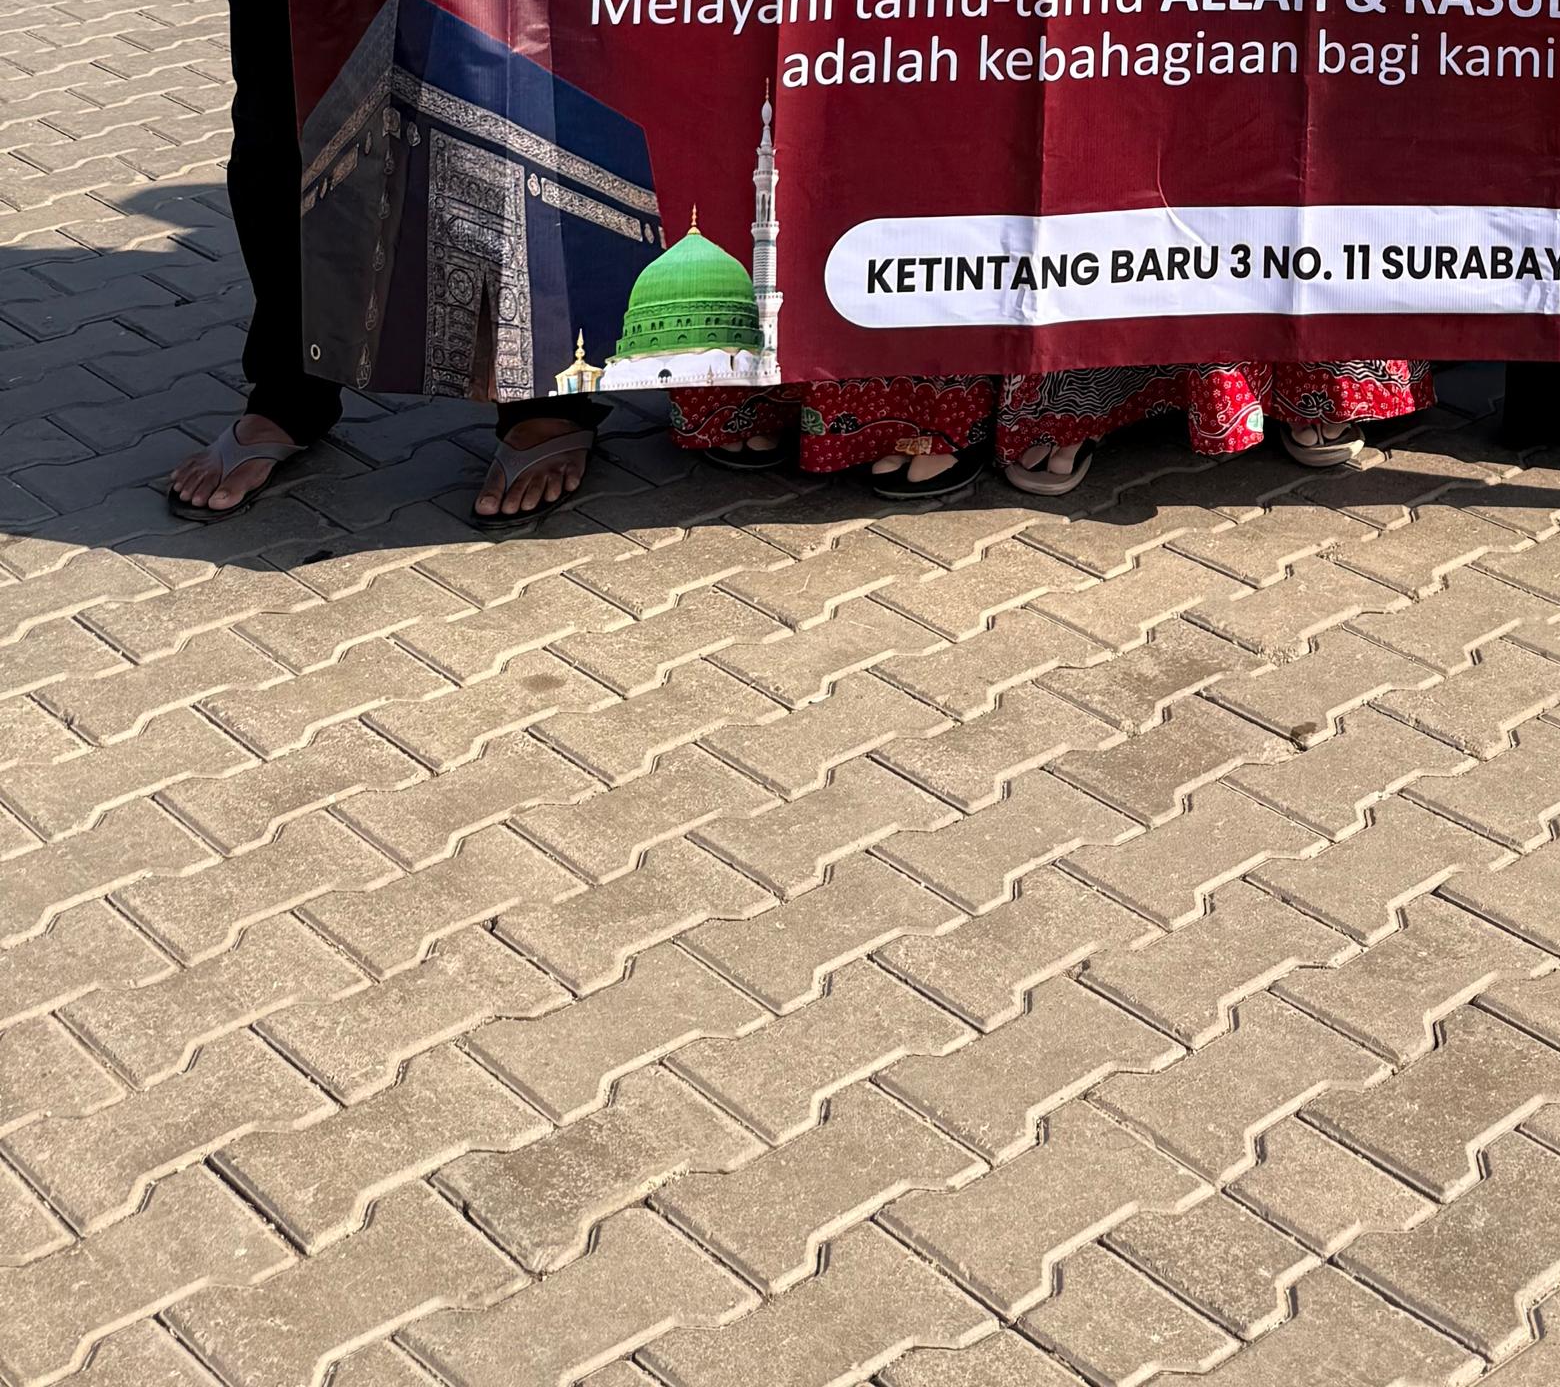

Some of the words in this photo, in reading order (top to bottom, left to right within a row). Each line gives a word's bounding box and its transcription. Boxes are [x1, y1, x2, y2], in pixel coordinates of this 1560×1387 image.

[783, 36, 957, 87] adalah
[980, 31, 1296, 85] kebahagiaan
[1319, 29, 1418, 84] bagi
[1441, 33, 1554, 77] kami
[868, 253, 1099, 293] KETINTANG
[1111, 246, 1218, 283] BARU
[1231, 244, 1250, 278] 3
[1264, 246, 1331, 280] NO.
[1344, 245, 1369, 279] 11
